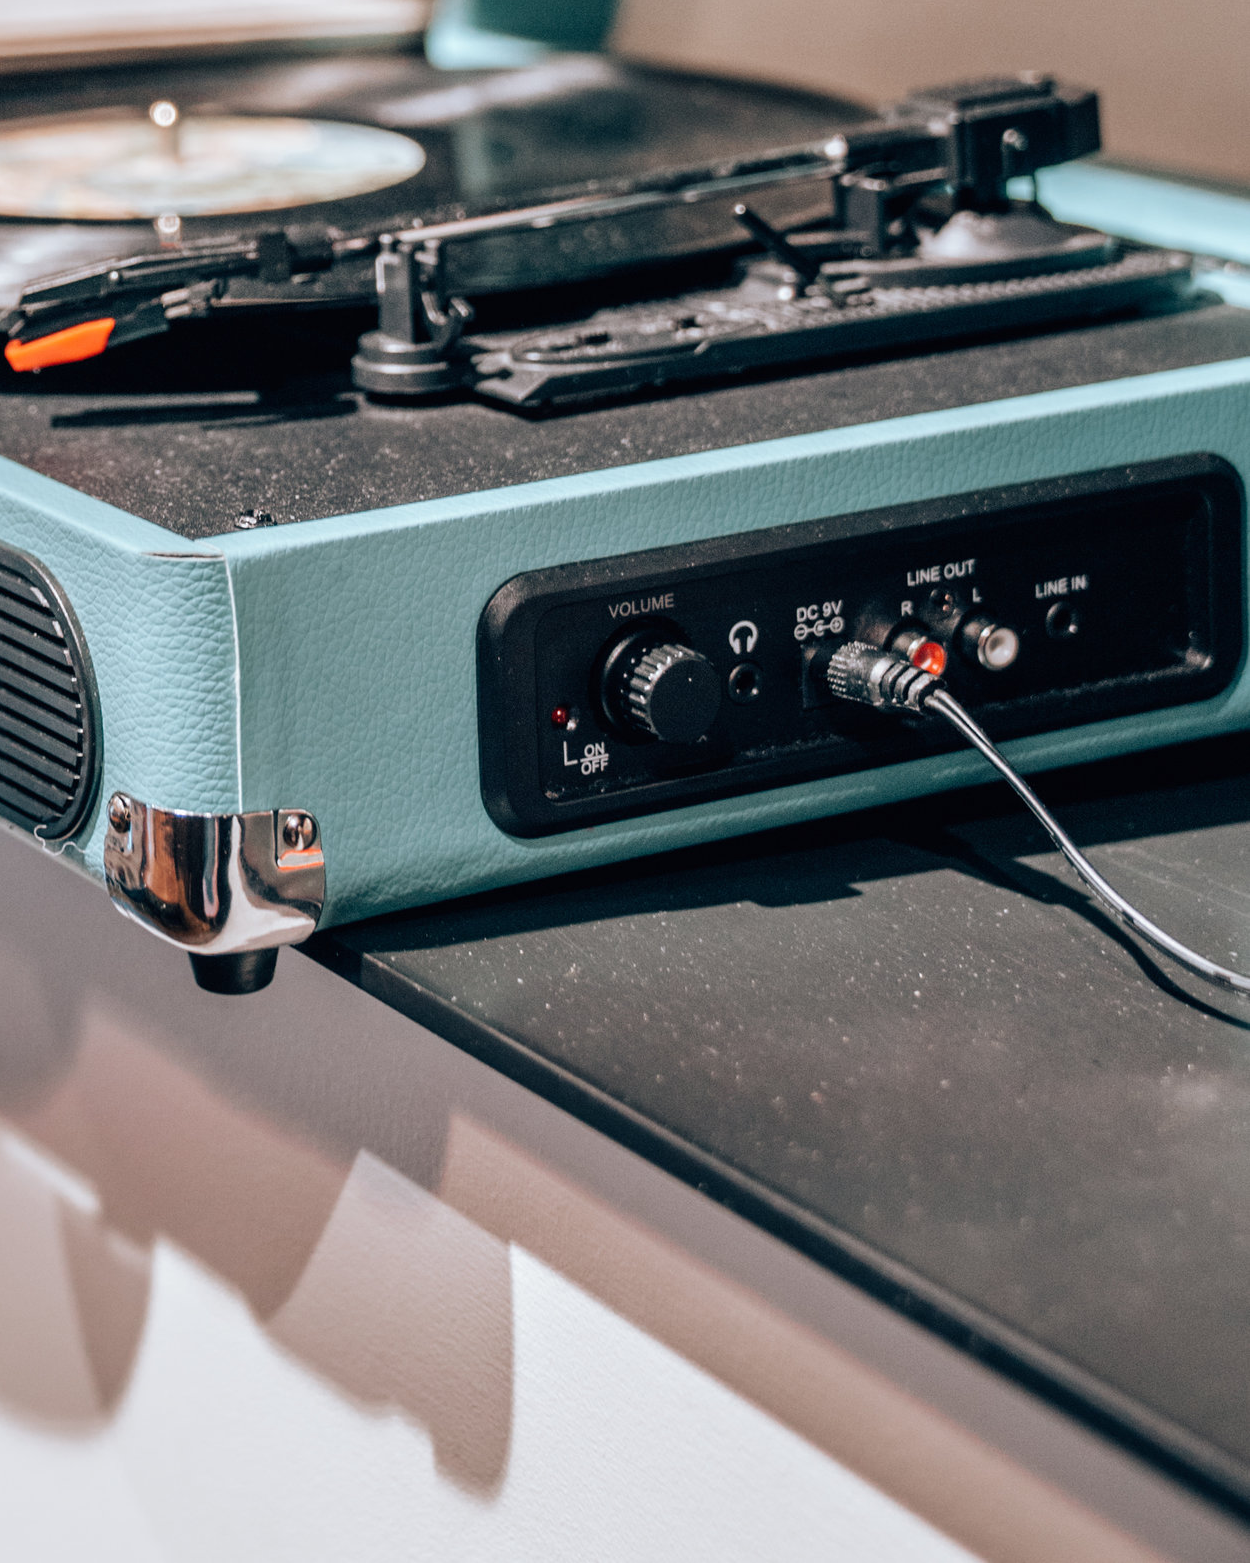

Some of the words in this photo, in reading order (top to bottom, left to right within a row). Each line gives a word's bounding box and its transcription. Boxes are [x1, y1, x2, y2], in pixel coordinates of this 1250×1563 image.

[907, 565, 941, 587] LINE
[944, 558, 976, 580] OUT
[972, 587, 982, 603] L
[1035, 577, 1068, 599] LINE
[1071, 574, 1087, 591] IN
[608, 592, 675, 619] VOLUME
[796, 605, 818, 623] DC
[822, 600, 844, 618] 9V
[901, 600, 914, 617] R
[584, 741, 605, 758] ON
[581, 757, 609, 775] OFF
